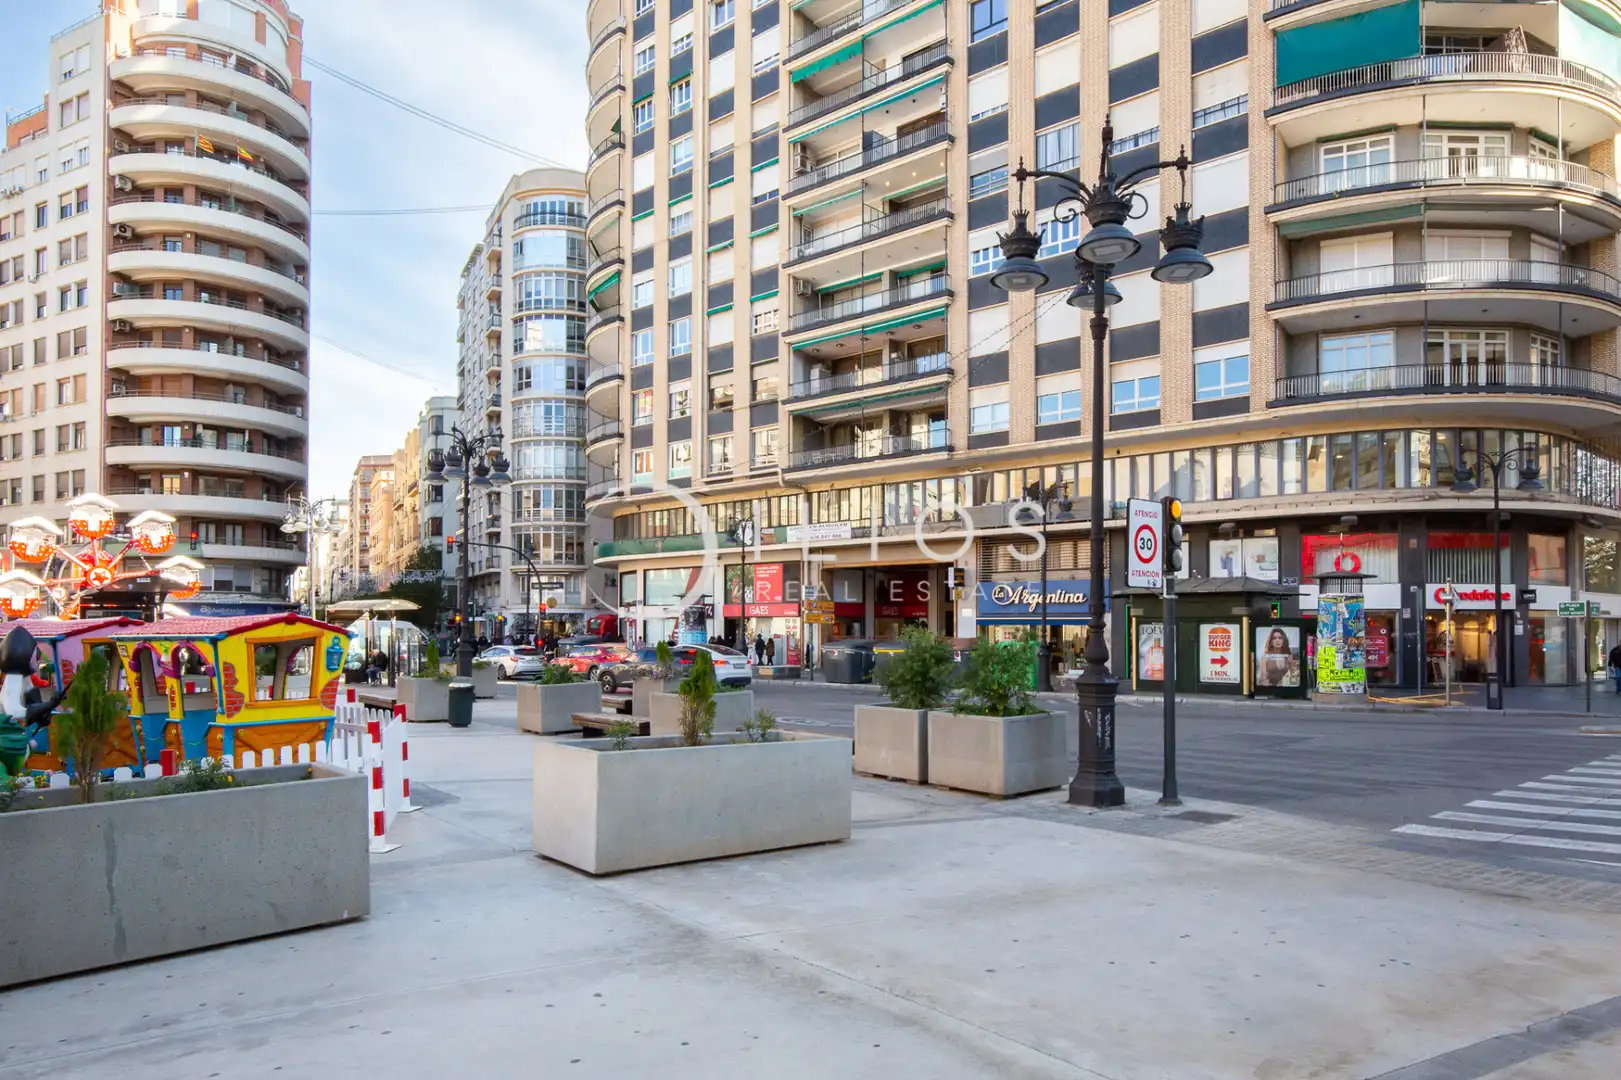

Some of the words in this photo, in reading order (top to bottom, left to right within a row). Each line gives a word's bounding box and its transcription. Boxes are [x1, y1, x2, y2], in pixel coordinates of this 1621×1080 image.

[1134, 509, 1158, 519] ATENCIÓ
[1139, 537, 1153, 551] 30
[1131, 569, 1160, 578] ATENCIÓN
[994, 588, 1004, 598] La
[1452, 589, 1511, 601] odafoe
[749, 605, 768, 615] GAES
[1208, 639, 1232, 648] KING
